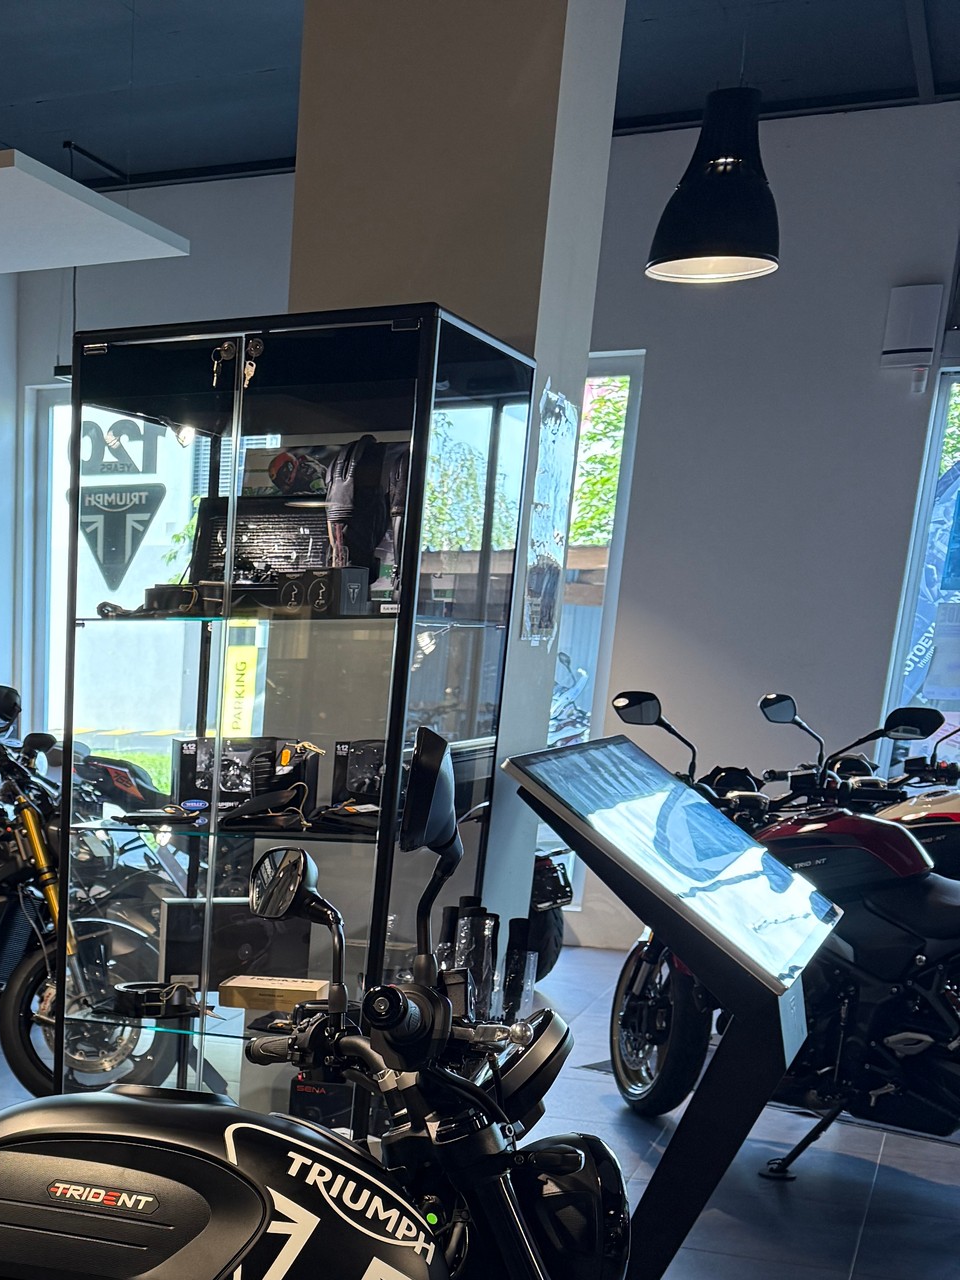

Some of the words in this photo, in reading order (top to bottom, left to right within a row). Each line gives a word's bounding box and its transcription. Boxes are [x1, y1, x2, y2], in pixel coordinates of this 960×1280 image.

[231, 661, 247, 730] PARKING
[296, 1085, 327, 1095] SENA
[49, 1182, 154, 1210] TRIDENT
[287, 1151, 435, 1266] TRIUMPH
